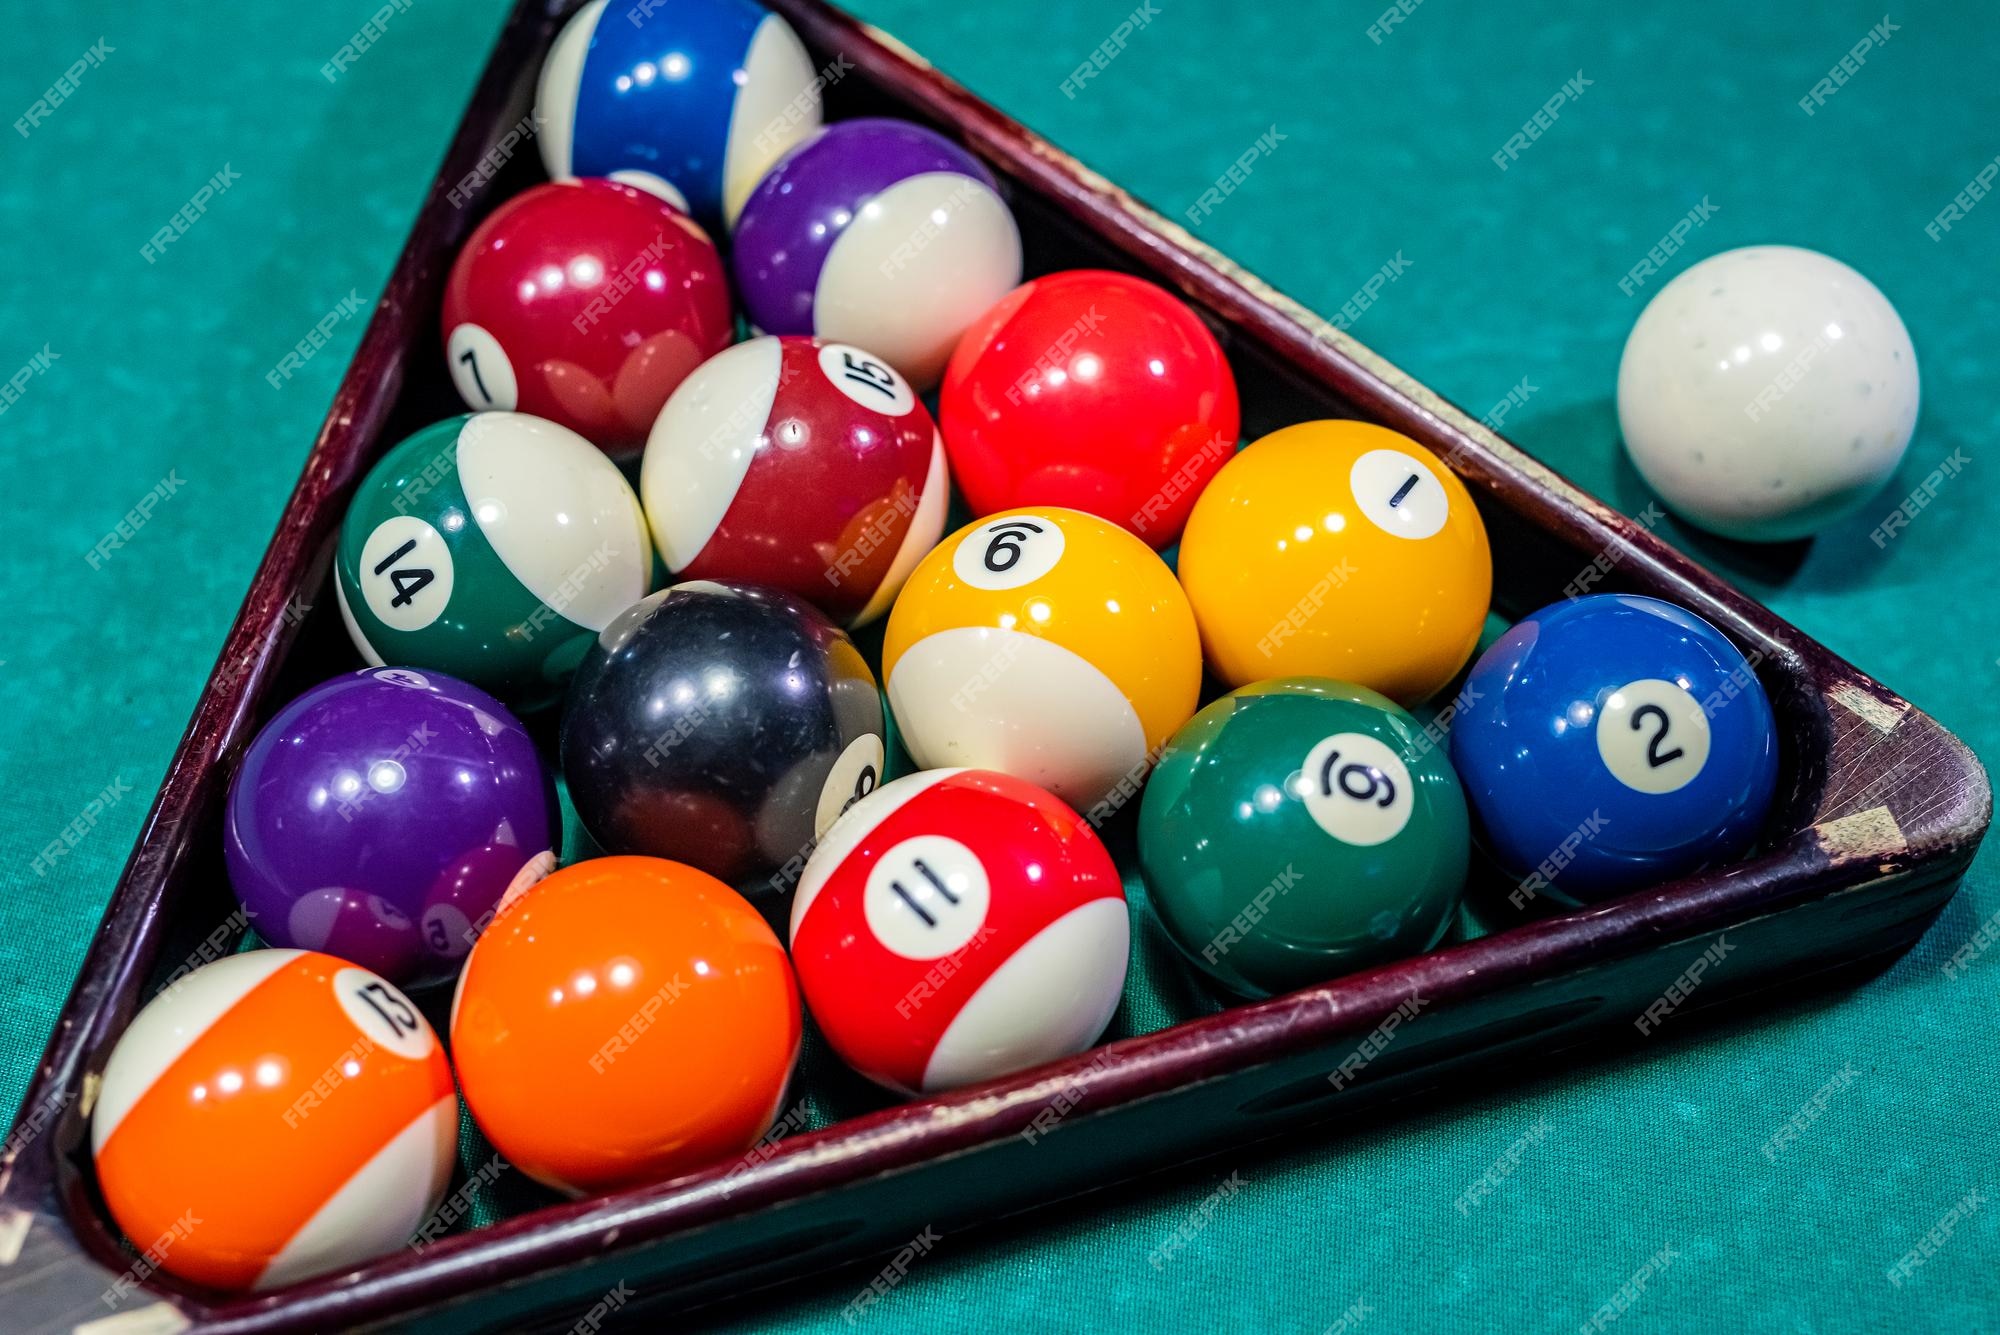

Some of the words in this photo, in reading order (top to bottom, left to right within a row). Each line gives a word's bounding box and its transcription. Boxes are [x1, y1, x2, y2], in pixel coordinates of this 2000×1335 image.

[460, 350, 491, 403] 7
[843, 352, 895, 400] 15
[1389, 473, 1419, 507] 1
[375, 539, 434, 608] 14
[1631, 705, 1683, 767] 2
[892, 859, 959, 926] 11
[356, 983, 416, 1038] 13
